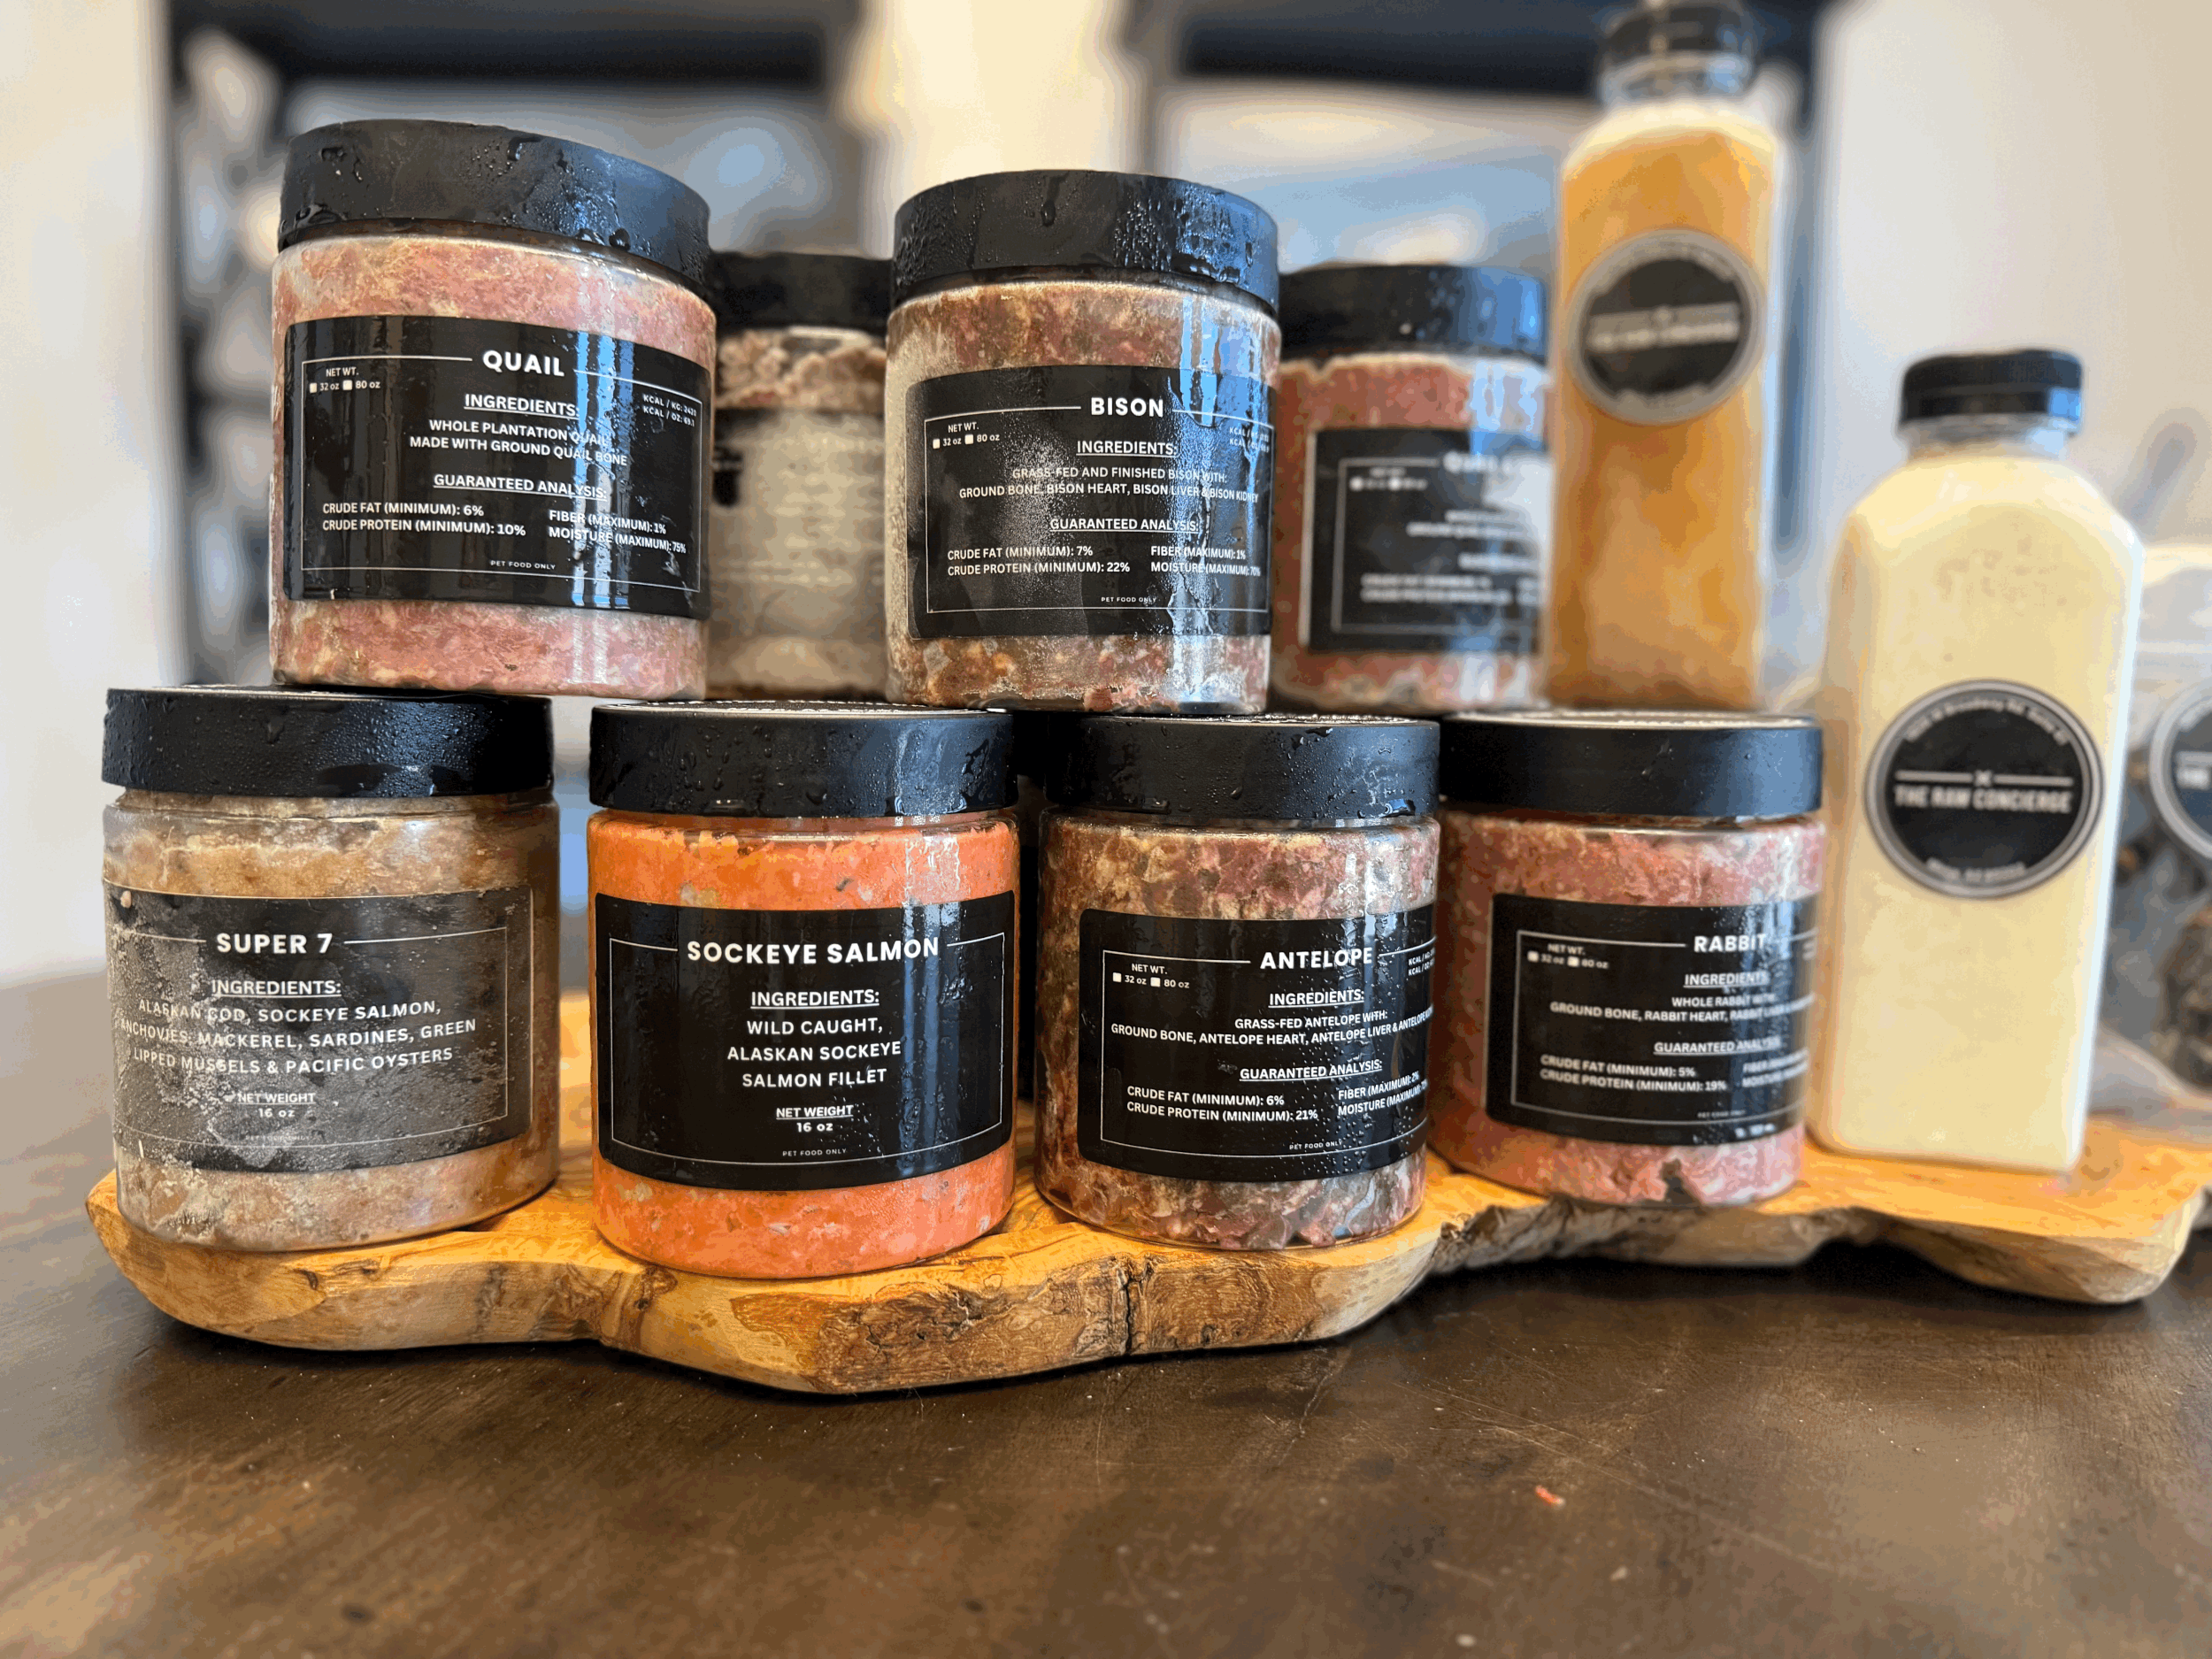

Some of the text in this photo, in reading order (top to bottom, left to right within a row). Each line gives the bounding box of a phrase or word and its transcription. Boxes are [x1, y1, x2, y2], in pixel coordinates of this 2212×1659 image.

[326, 366, 359, 377] NET WT.
[483, 349, 565, 377] QUAIL
[319, 382, 329, 391] 32
[355, 380, 367, 389] 80
[465, 394, 580, 417] INGREDIENTS:
[642, 394, 664, 407] KCAL
[1090, 396, 1164, 418] BISON
[642, 405, 664, 418] KCAL
[429, 419, 611, 446] WHOLE PLANTATION QUAIL
[948, 422, 979, 434] NET WT.
[976, 434, 987, 442] 80
[410, 436, 627, 465] MADE WITH GROUND QUAIL BONE
[1077, 441, 1178, 455] INGREDIENTS:
[1012, 466, 1200, 481] GRASS-FED AND FINISHED BISON
[434, 474, 607, 499] GUARANTEED ANALYSIS:
[959, 483, 1234, 500] GROUND BISON HEART, BISON LIVER BISON
[323, 502, 484, 517] CRUDE FAT (MINIMUM): 6%
[322, 519, 526, 536] CRUDE PROTEIN (MINIMUM): 10%
[549, 510, 653, 533] FIBER (MAXIMUM):
[1050, 518, 1199, 532] GUARANTEED ANALYSIS:
[549, 526, 672, 551] MOISTURE (MAXIMUM):
[948, 545, 1094, 560] CRUDE FAT (MINIMUM): 7%
[1150, 546, 1236, 560] FIBER (MAXIMUM):
[508, 560, 532, 569] FOOD
[948, 561, 1131, 576] CRUDE PROTEIN (MINIMUM): 22%
[1150, 562, 1205, 572] MOISTURE
[1894, 784, 1930, 809] THE
[1931, 785, 1971, 809] RAW
[216, 933, 334, 954] SUPER 7
[687, 936, 939, 964] SOCKEYE SALMON
[1694, 933, 1766, 953] RABBIT
[1260, 947, 1373, 970] ANTELOPE
[1131, 963, 1168, 975] NET WT.
[211, 979, 342, 995] INGREDIENTS:
[1124, 975, 1134, 984] 32
[1164, 979, 1176, 987] 80
[751, 988, 879, 1006] INGREDIENTS:
[1269, 988, 1364, 1005] INGREDIENTS:
[1671, 996, 1713, 1008] WHOLE
[139, 998, 442, 1023] ALASKAN SOCKEYE SALMON,
[1549, 1001, 1728, 1022] GROUND BONE, RABBIT HEART,
[746, 1018, 883, 1035] WILD CAUGHT,
[1234, 1010, 1387, 1029] GRASS-FED ANTELOPE WITH:
[198, 1018, 476, 1049] MACKEREL, SARDINES, GREEN
[1111, 1023, 1391, 1046] GROUND BONE, ANTELOPE HEART, ANTELOPE LIVER
[726, 1041, 902, 1062] ALASKAN SOCKEYE
[1654, 1041, 1735, 1053] GUARANTEED
[134, 1047, 453, 1073] LIPPED MUSSELS & PACIFIC OYSTERS
[1540, 1054, 1696, 1078] CRUDE FAT (MINIMUM): 5%
[1240, 1059, 1383, 1079] GUARANTEED ANALYSIS:
[741, 1068, 887, 1088] SALMON FILLET
[1540, 1068, 1727, 1092] CRUDE PROTEIN (MINIMUM): 19%
[1338, 1087, 1365, 1101] FIBER
[1367, 1074, 1411, 1097] (MAXIMUM):
[237, 1092, 316, 1103] NET WEIGHT
[1126, 1086, 1285, 1107] CRUDE FAT (MINIMUM): 6%
[258, 1107, 273, 1118] 16
[776, 1104, 854, 1118] NET WEIGHT
[1126, 1101, 1318, 1123] CRUDE PROTEIN (MINIMUM): 21%
[1338, 1097, 1386, 1117] MOISTURE
[796, 1122, 833, 1133] 16 oz
[826, 1147, 847, 1156] ONLY
